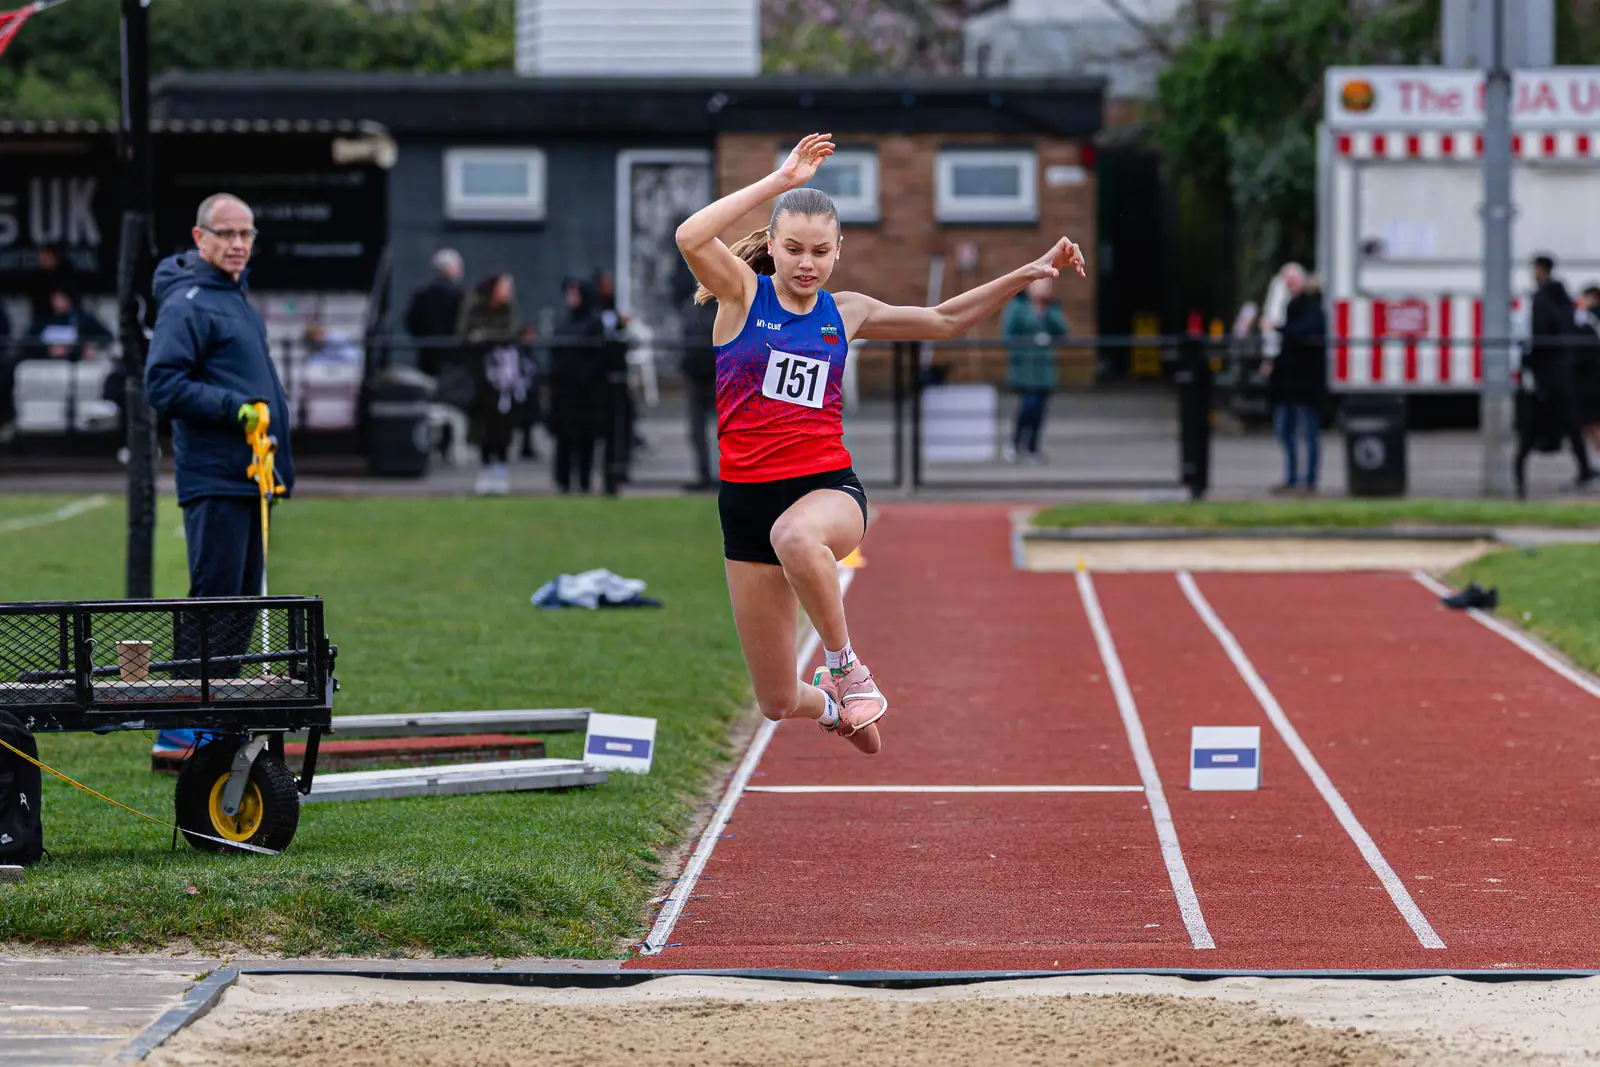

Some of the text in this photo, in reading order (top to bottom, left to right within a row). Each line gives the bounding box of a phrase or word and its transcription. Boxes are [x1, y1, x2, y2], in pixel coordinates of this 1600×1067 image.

[1394, 80, 1464, 114] The
[30, 177, 101, 245] UK
[775, 357, 820, 401] 151
